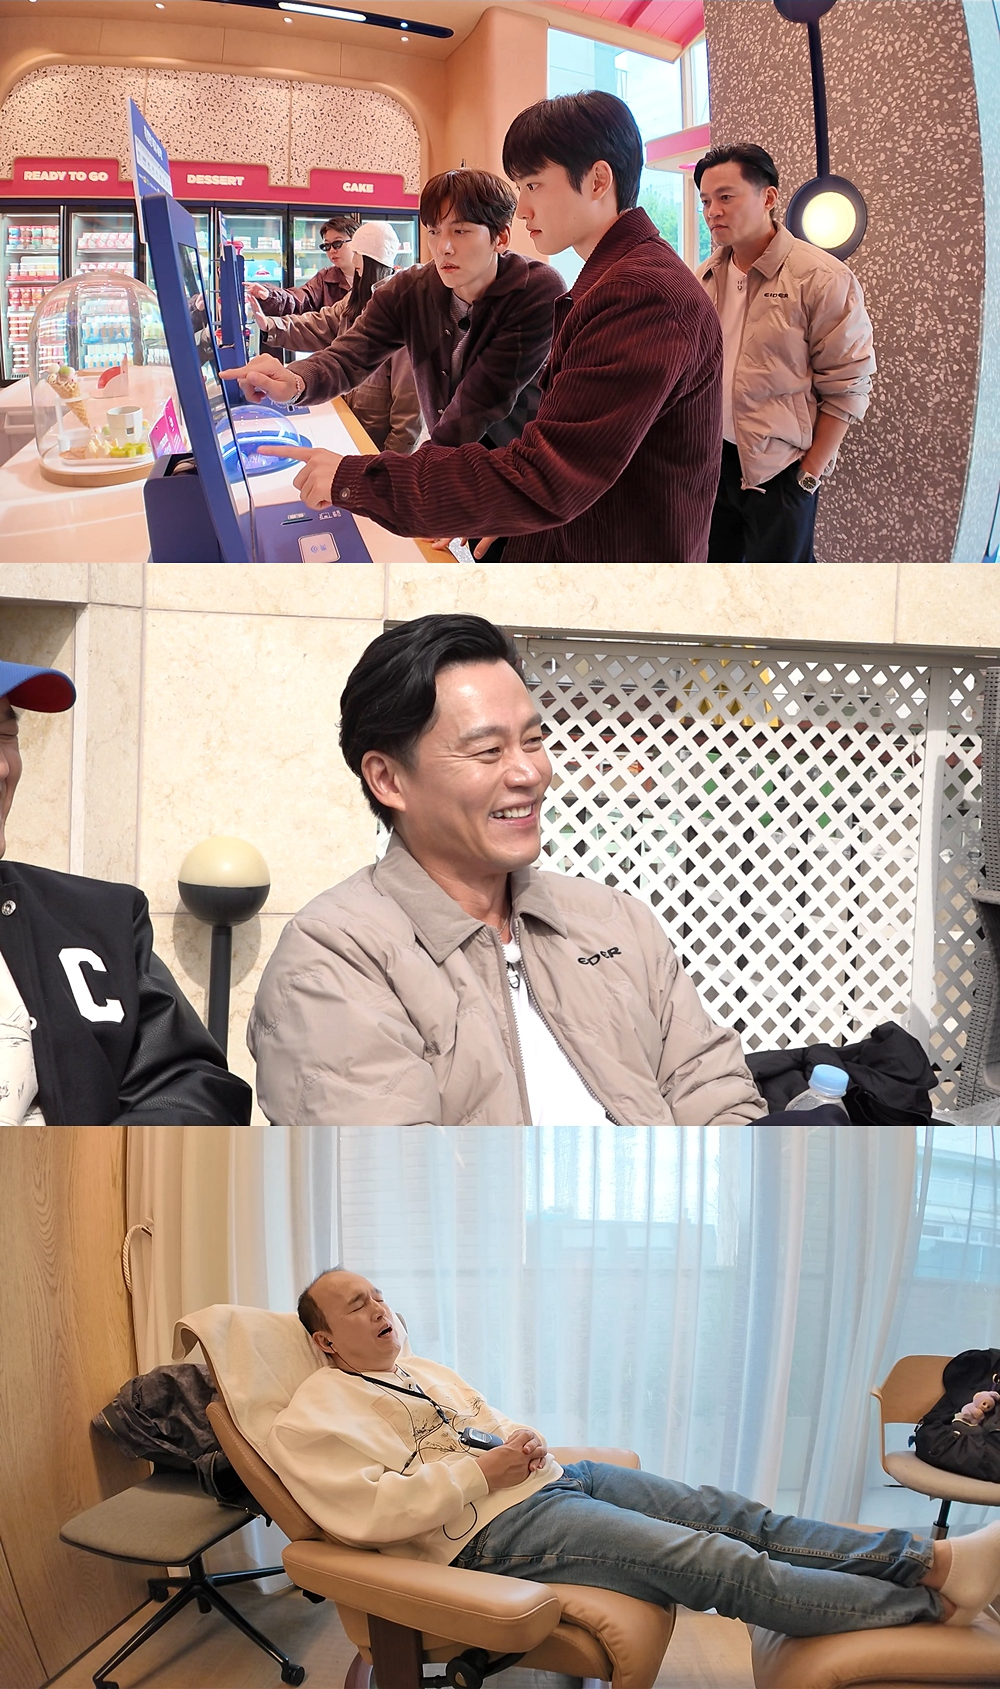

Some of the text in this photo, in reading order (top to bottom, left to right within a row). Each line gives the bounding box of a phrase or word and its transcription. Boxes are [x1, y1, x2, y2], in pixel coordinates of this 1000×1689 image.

[23, 171, 109, 182] READY TO GO
[186, 174, 245, 186] DESSERT
[342, 182, 374, 193] CAKE
[58, 947, 125, 1023] C
